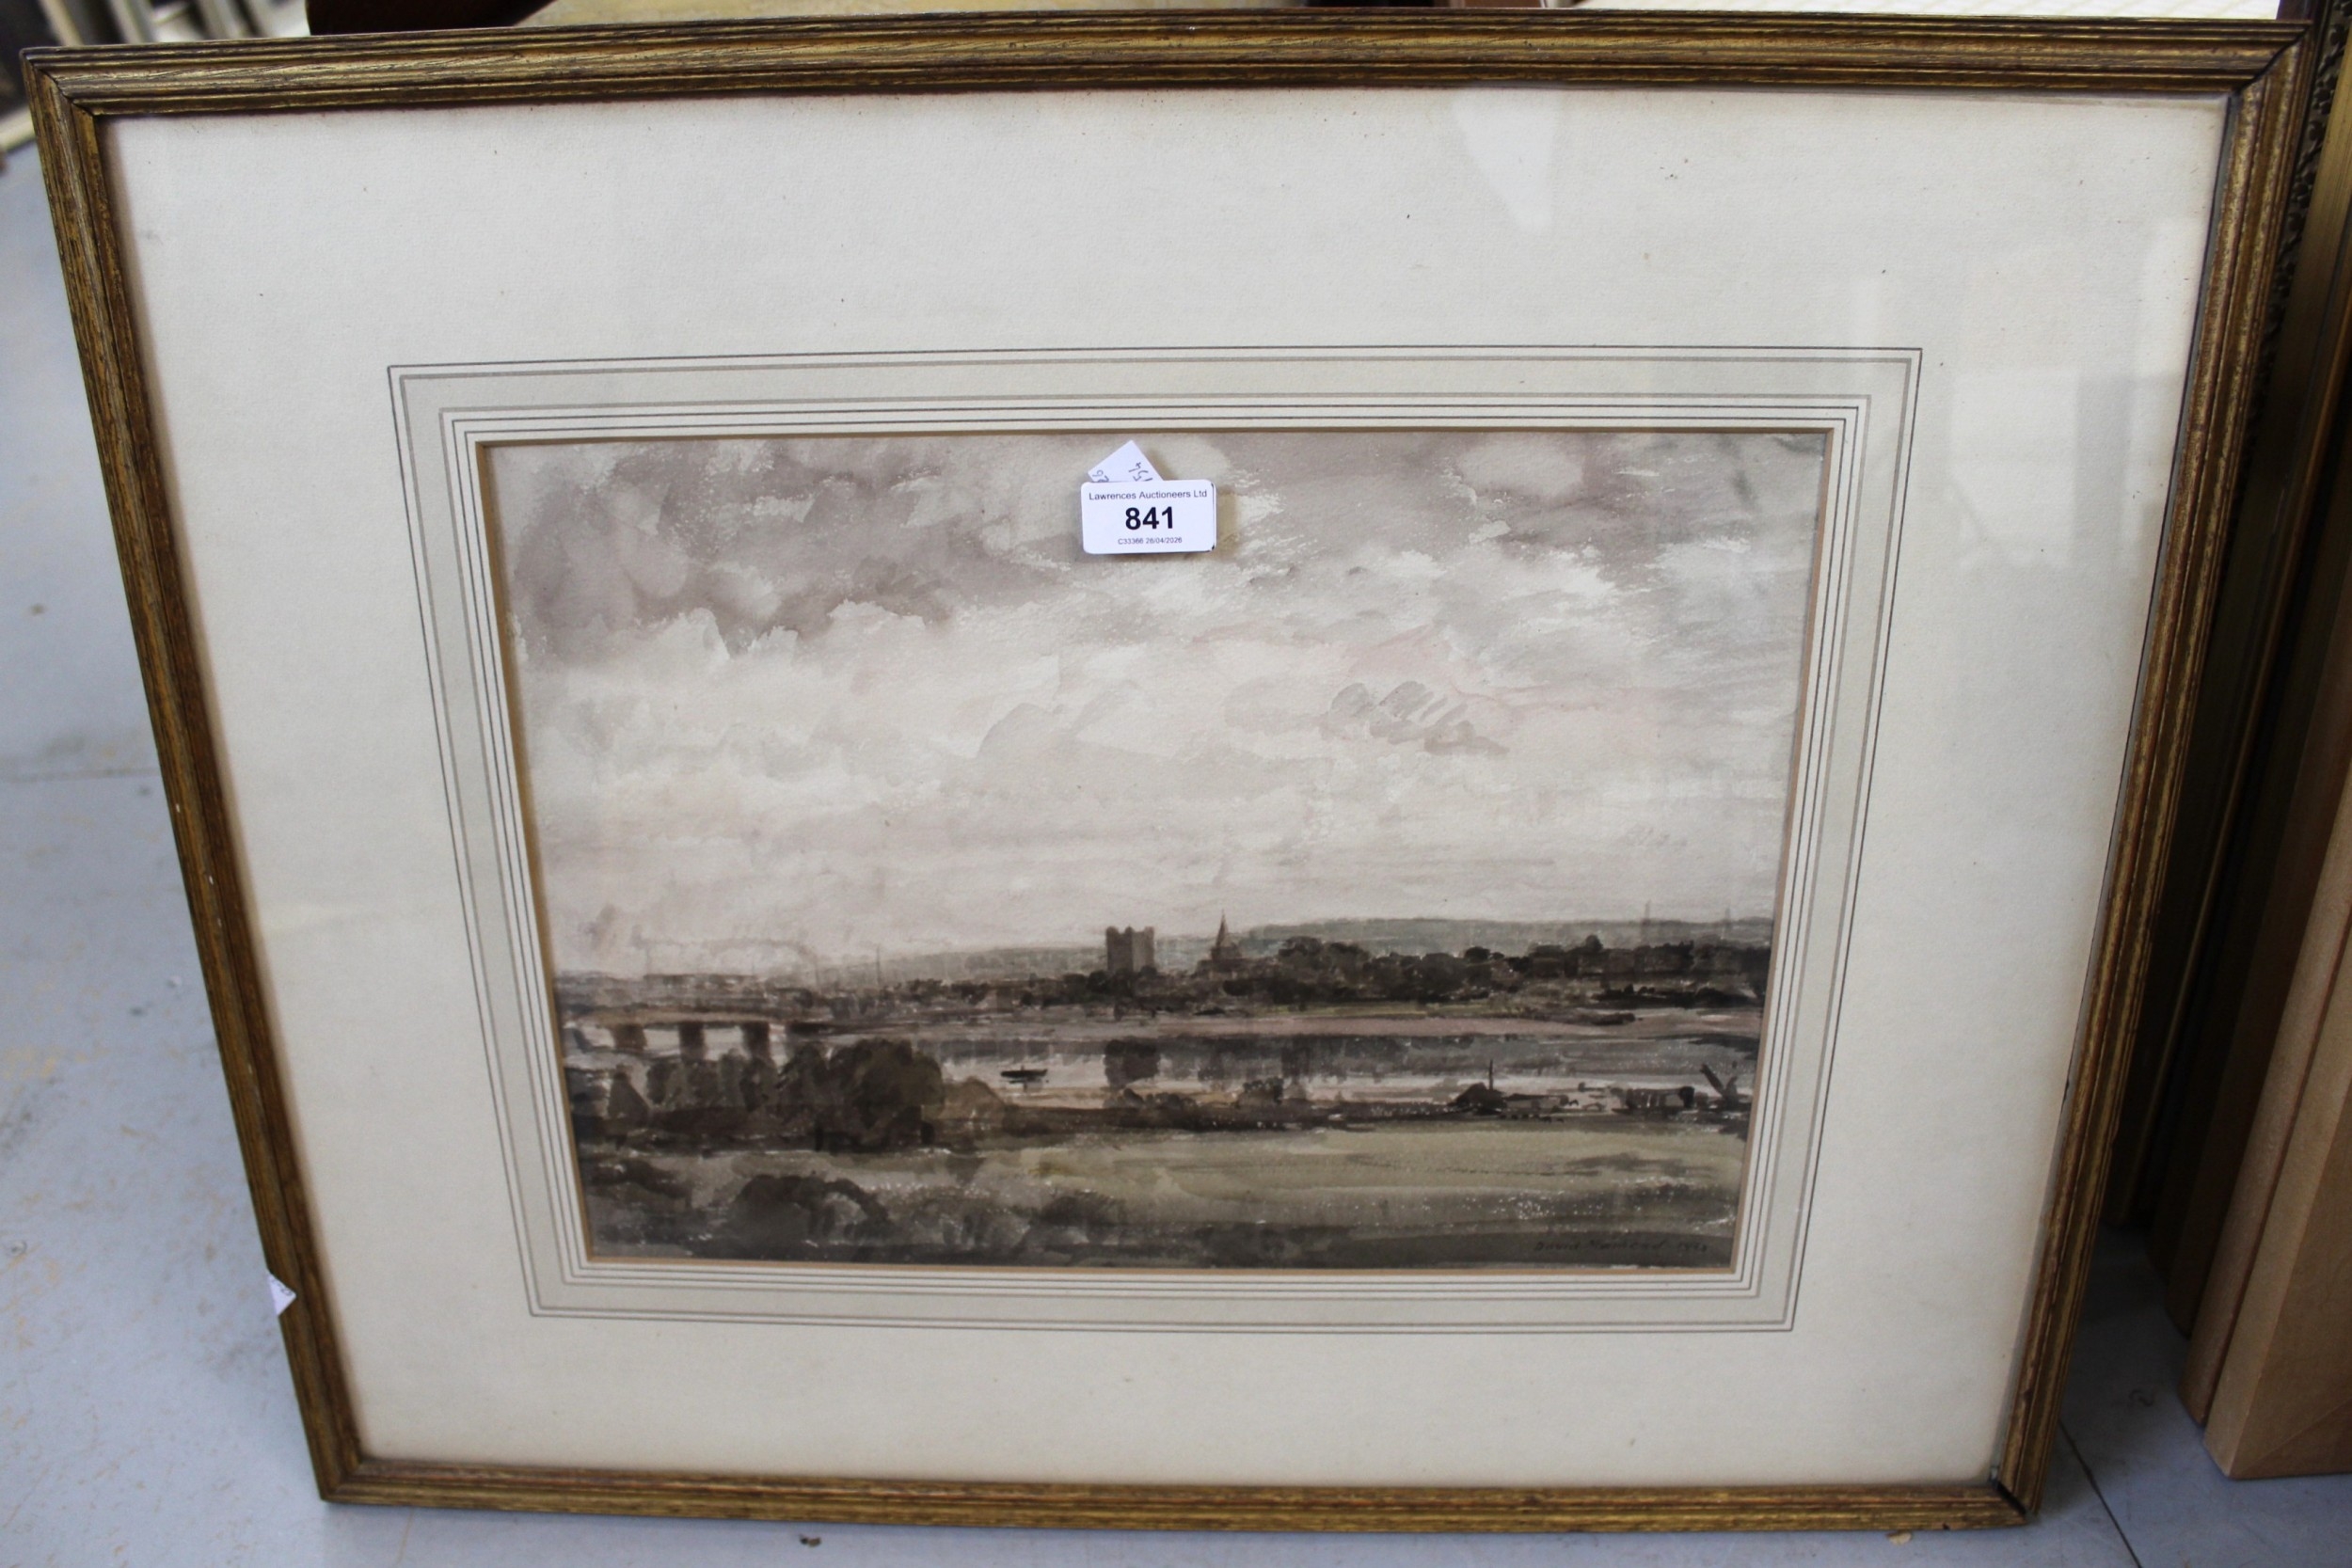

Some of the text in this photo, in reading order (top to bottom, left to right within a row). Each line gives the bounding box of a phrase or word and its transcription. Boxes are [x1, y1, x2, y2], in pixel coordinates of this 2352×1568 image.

[1089, 489, 1208, 500] Lawrences Auctioneers Ltd
[1125, 505, 1174, 531] 841
